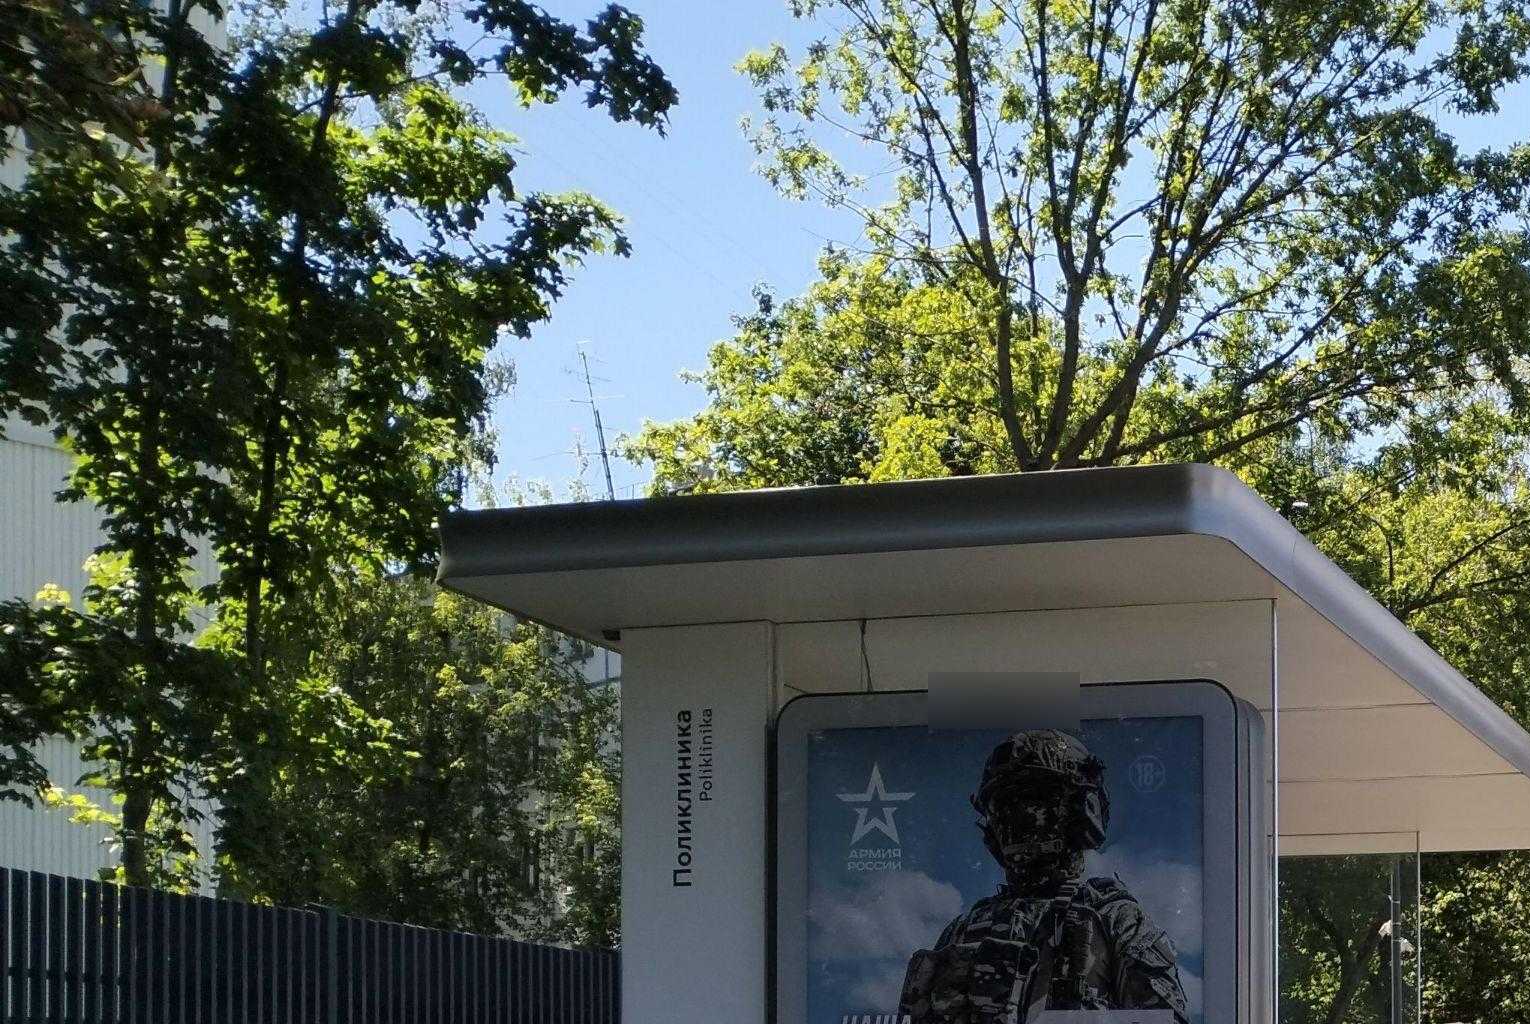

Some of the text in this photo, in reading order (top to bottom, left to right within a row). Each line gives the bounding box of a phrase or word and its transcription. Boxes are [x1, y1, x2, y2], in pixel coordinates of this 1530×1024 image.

[699, 708, 713, 801] Poliklinika
[1136, 762, 1162, 786] 18+
[672, 709, 693, 887] Поликлиника
[848, 848, 902, 860] АРМИЯ
[847, 861, 903, 872] РОССИИ
